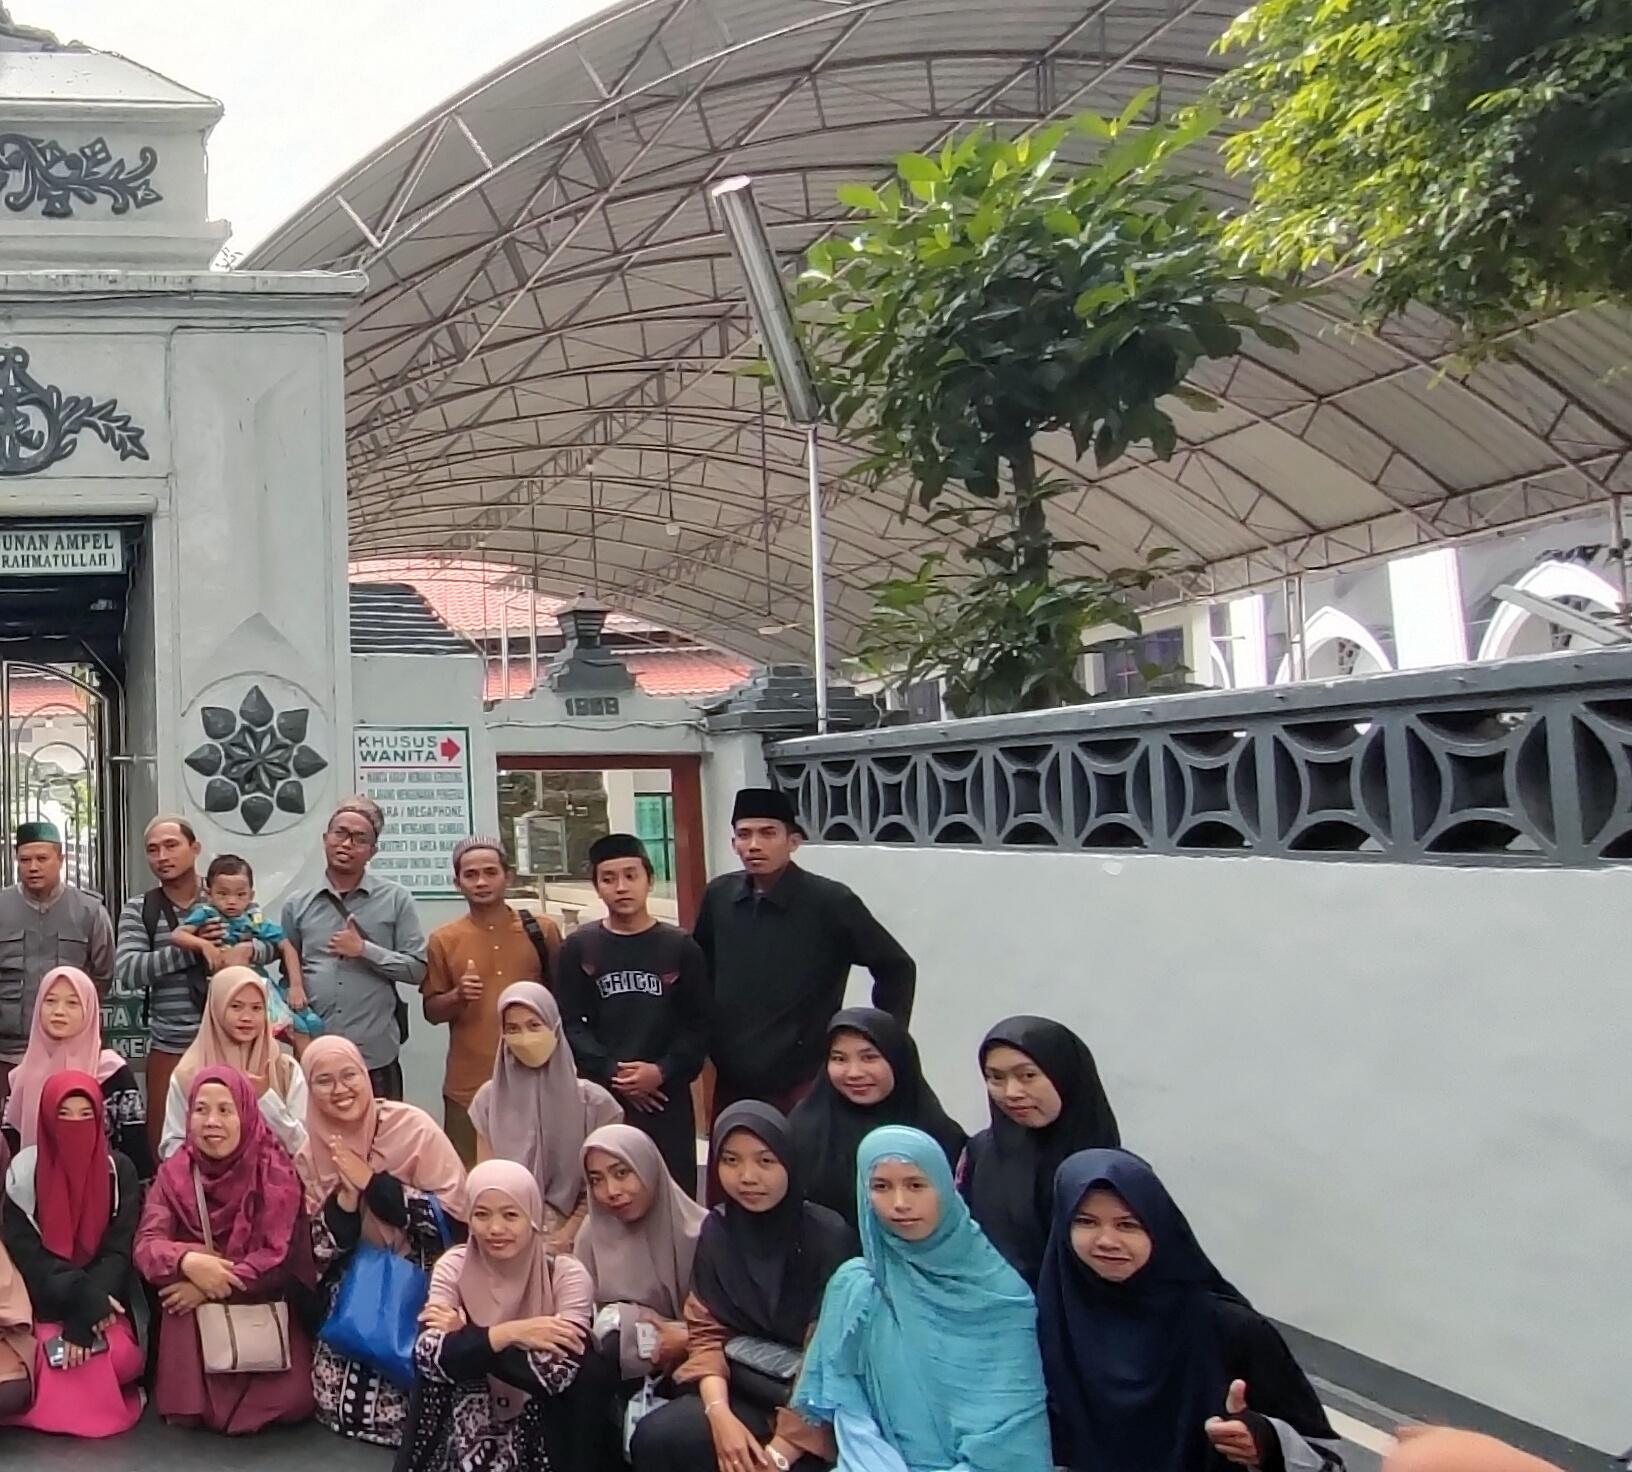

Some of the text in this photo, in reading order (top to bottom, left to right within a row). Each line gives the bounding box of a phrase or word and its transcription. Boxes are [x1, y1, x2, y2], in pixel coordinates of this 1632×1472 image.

[54, 532, 114, 550] AMPEL
[358, 735, 438, 749] KHUSUS
[359, 750, 438, 763] WANITA
